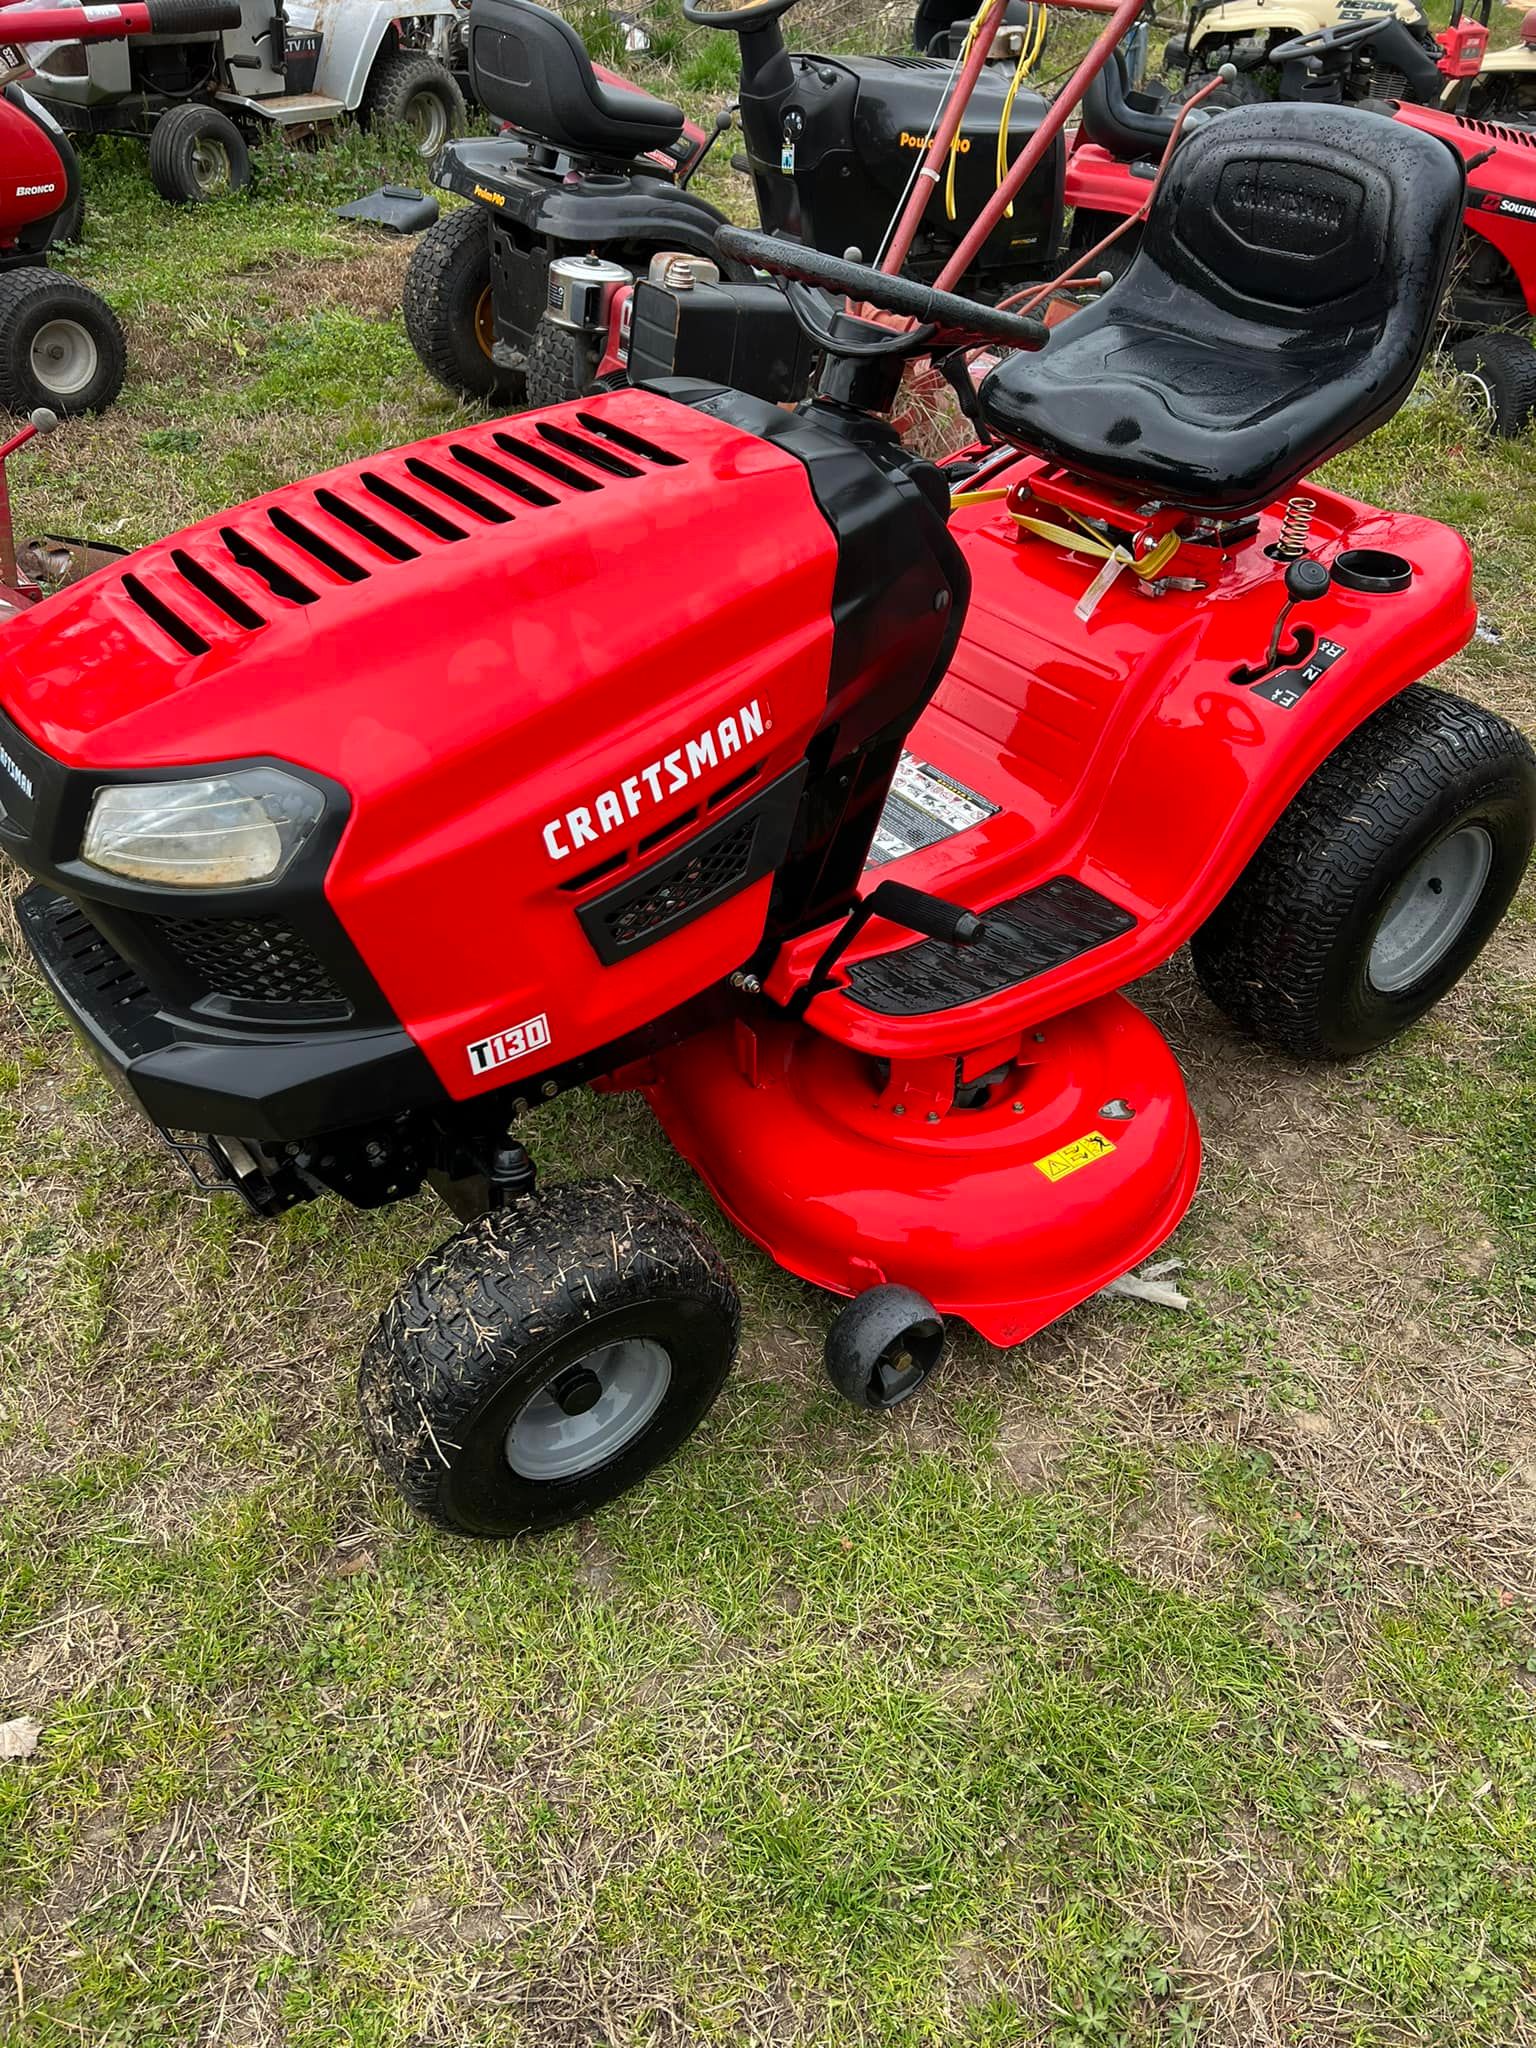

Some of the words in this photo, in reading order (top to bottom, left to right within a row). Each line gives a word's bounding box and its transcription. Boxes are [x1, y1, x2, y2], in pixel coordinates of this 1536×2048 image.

[1338, 10, 1365, 20] ES
[16, 183, 55, 197] BRONCO
[543, 699, 765, 861] CRAFTSMAN
[470, 1019, 547, 1069] T130
